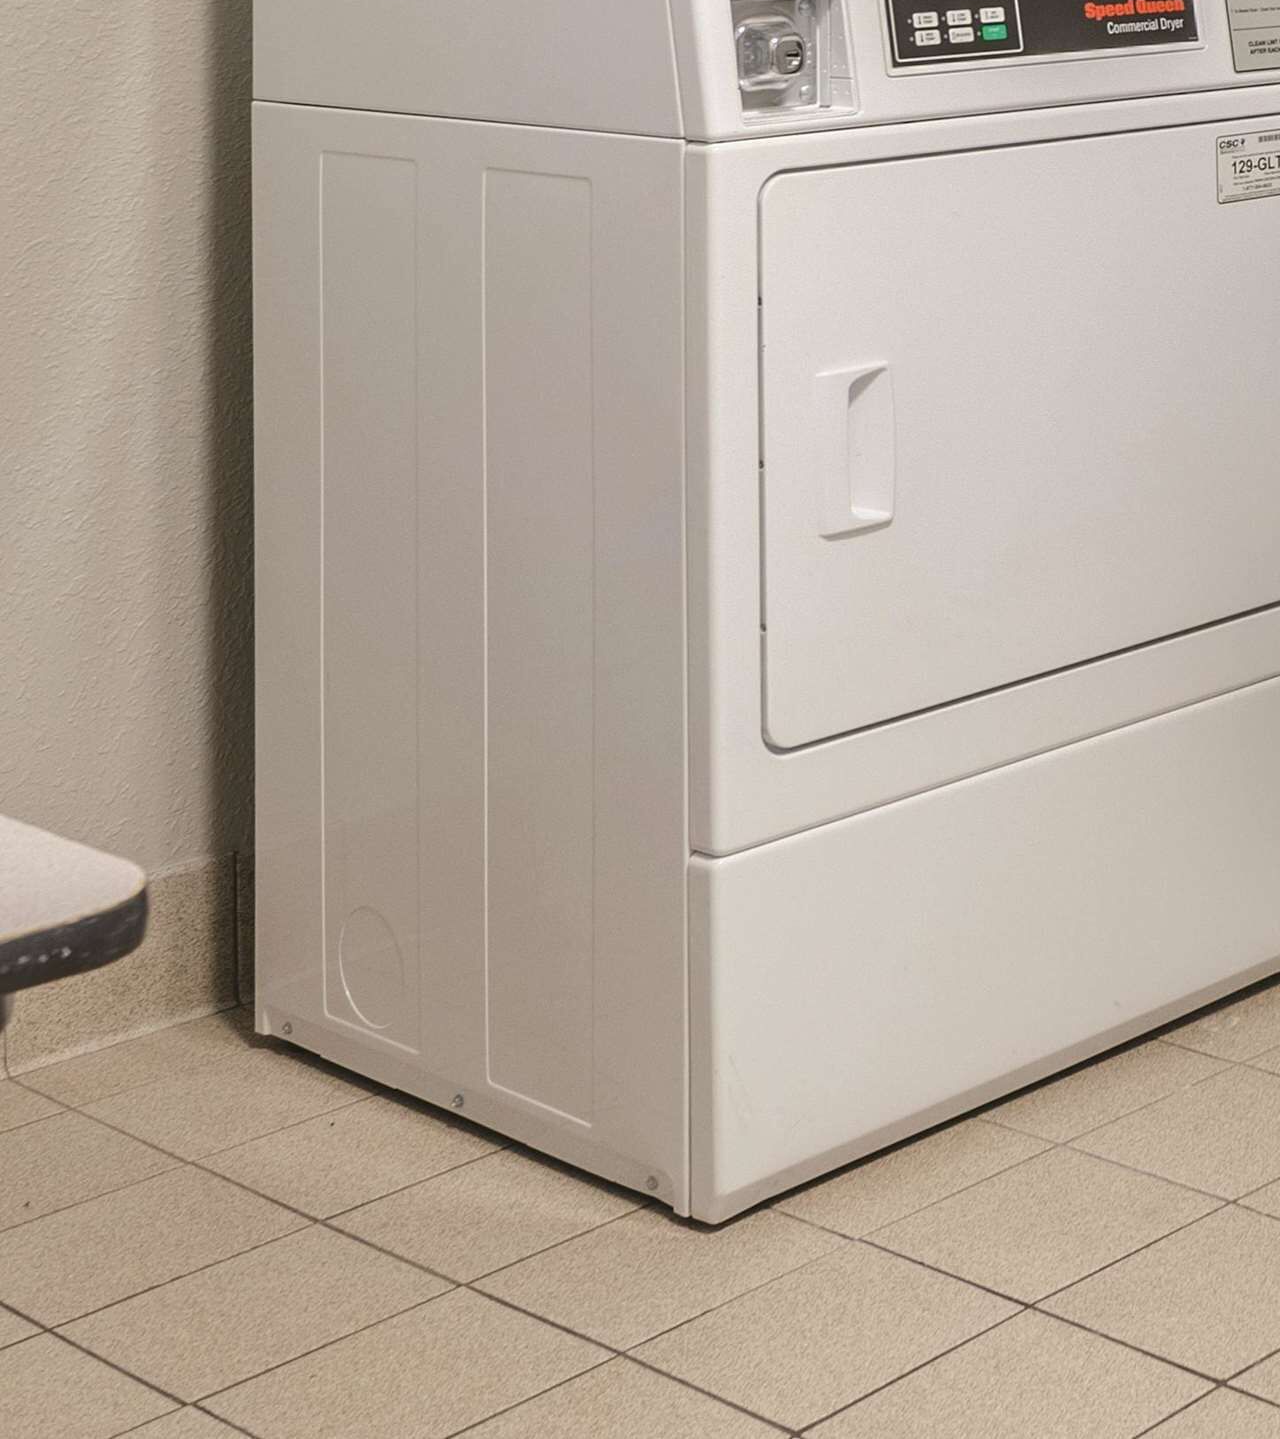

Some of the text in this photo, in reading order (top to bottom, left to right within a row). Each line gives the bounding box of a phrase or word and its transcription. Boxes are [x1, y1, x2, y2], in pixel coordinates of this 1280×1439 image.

[1084, 0, 1134, 20] Speed
[1107, 18, 1183, 34] Commercial Dryer
[1219, 139, 1238, 149] CSC
